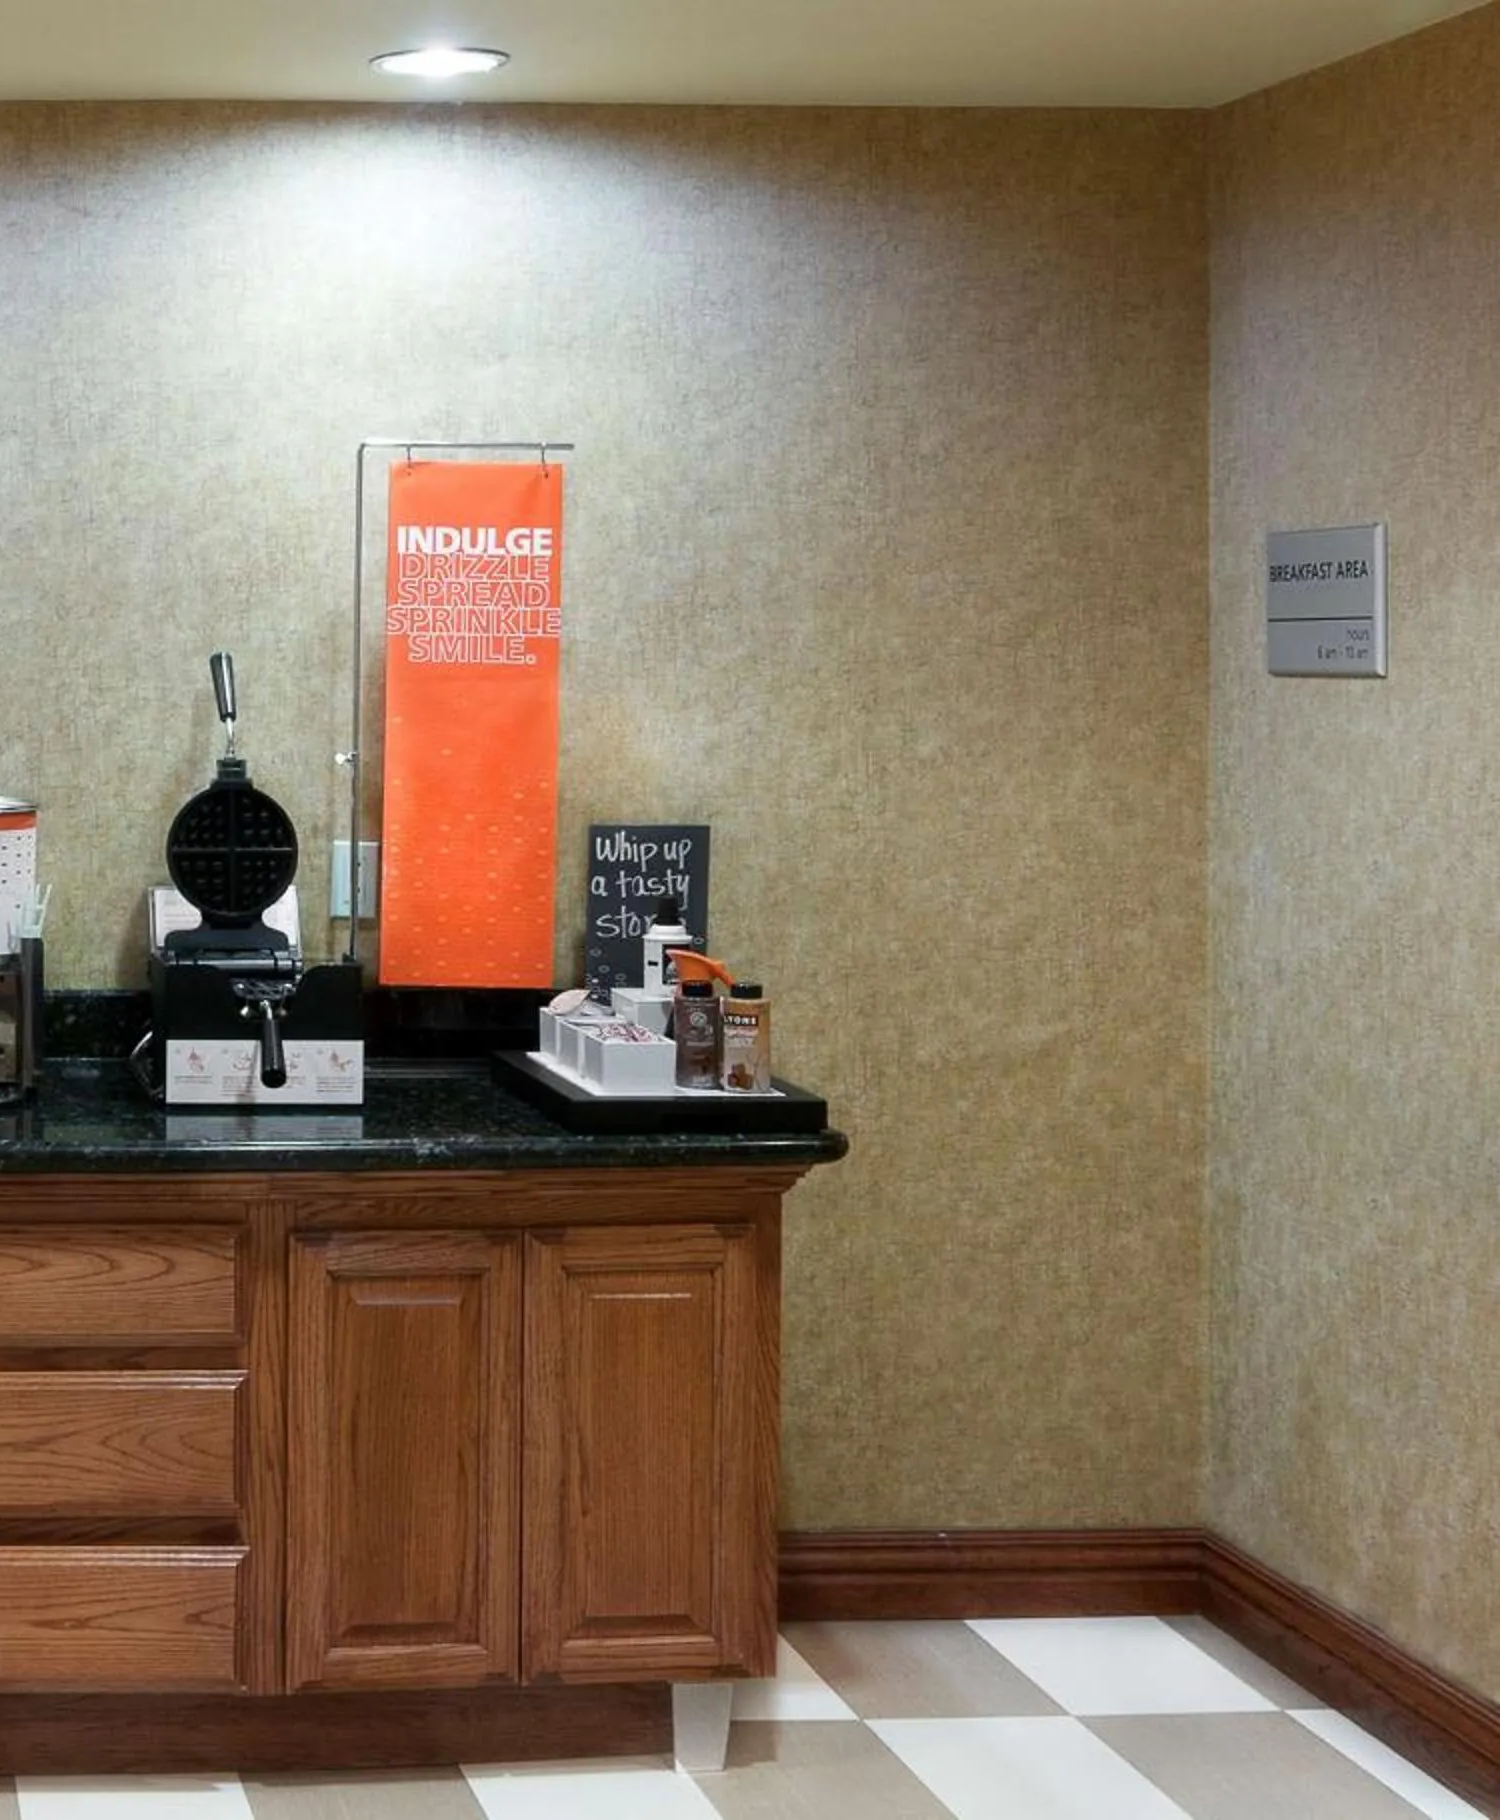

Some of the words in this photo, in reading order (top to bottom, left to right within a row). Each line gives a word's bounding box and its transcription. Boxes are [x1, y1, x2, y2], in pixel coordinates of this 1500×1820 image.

[397, 526, 553, 556] INDULGE
[400, 552, 550, 582] DRIZZLE
[1269, 561, 1333, 583] BREAKFAST
[1336, 559, 1369, 579] AREA
[397, 578, 550, 609] SPREAD
[387, 605, 562, 637] SPRINKLE
[408, 634, 537, 664] SMILE.
[595, 830, 658, 873] Whip
[663, 838, 693, 870] up
[591, 874, 609, 897] a
[615, 868, 690, 911] tasty
[595, 905, 687, 938] stor
